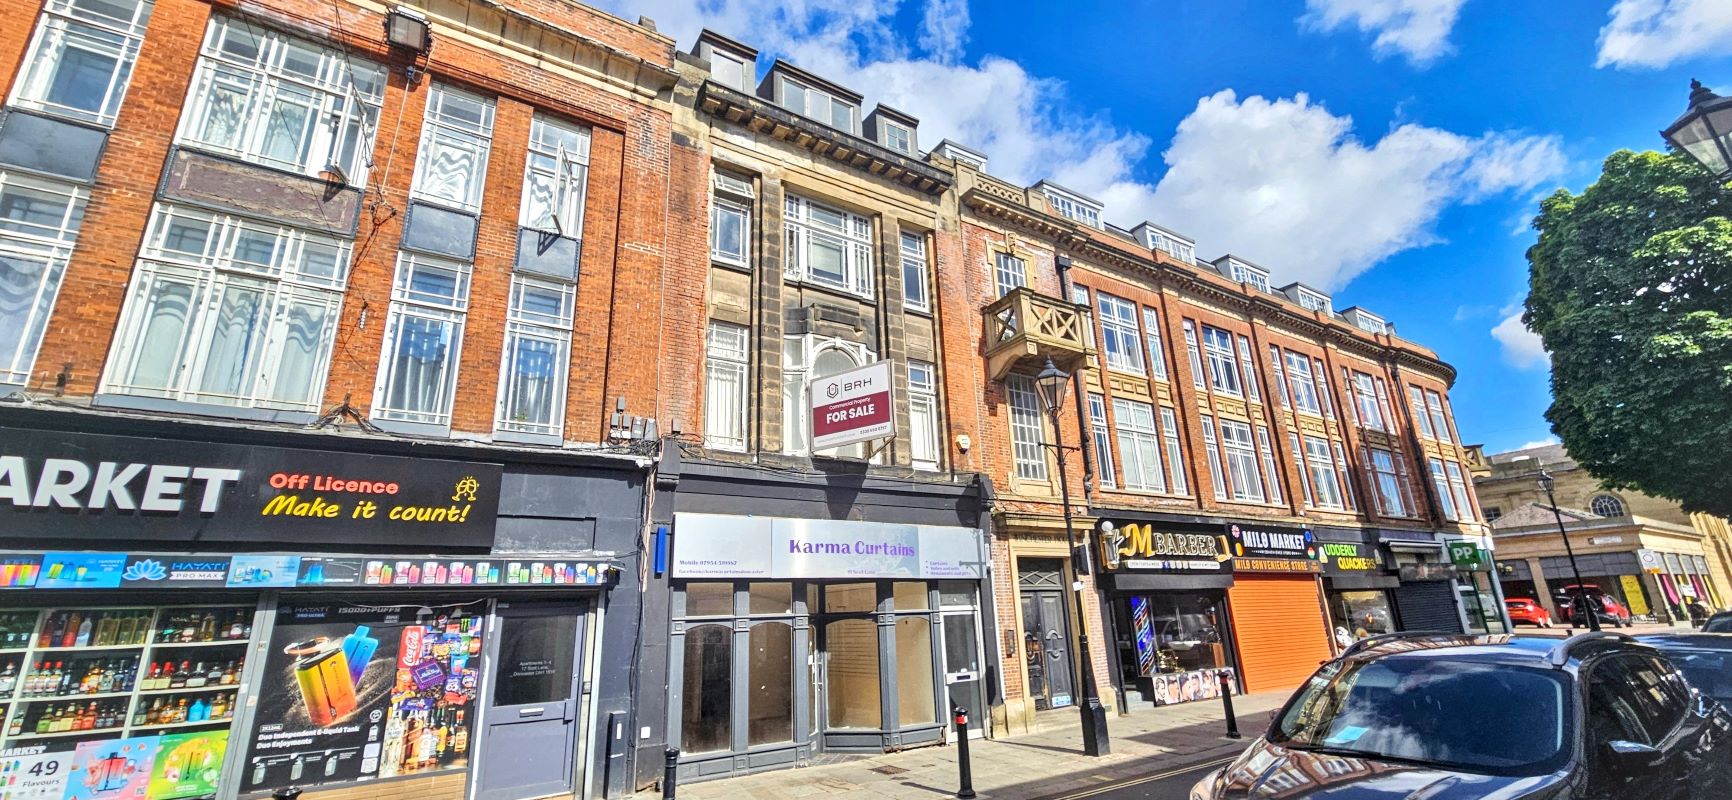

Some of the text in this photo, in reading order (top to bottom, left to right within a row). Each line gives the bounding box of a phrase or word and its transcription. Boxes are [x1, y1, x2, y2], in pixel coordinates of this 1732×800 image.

[844, 378, 872, 391] BRH
[829, 397, 871, 410] Commercial Property
[826, 404, 875, 424] FOR SALE
[0, 456, 241, 513] ARKET
[269, 473, 399, 495] Off Licence
[261, 495, 472, 523] Make it count!
[1153, 532, 1219, 557] BARBER
[1242, 530, 1305, 549] MILO MARKET
[789, 539, 916, 557] Karma Curtains
[1325, 543, 1357, 557] UDDERLY
[1453, 546, 1472, 561] PP
[172, 562, 226, 571] HAYATI
[1234, 559, 1250, 570] MILO
[1251, 560, 1290, 570] CONVENIENCE
[1291, 561, 1308, 571] STORE
[1337, 557, 1376, 570] QUACKERS
[273, 731, 317, 740] Independent
[271, 738, 313, 749] Enjoyments
[28, 760, 59, 776] 49
[23, 779, 60, 787] Flavours
